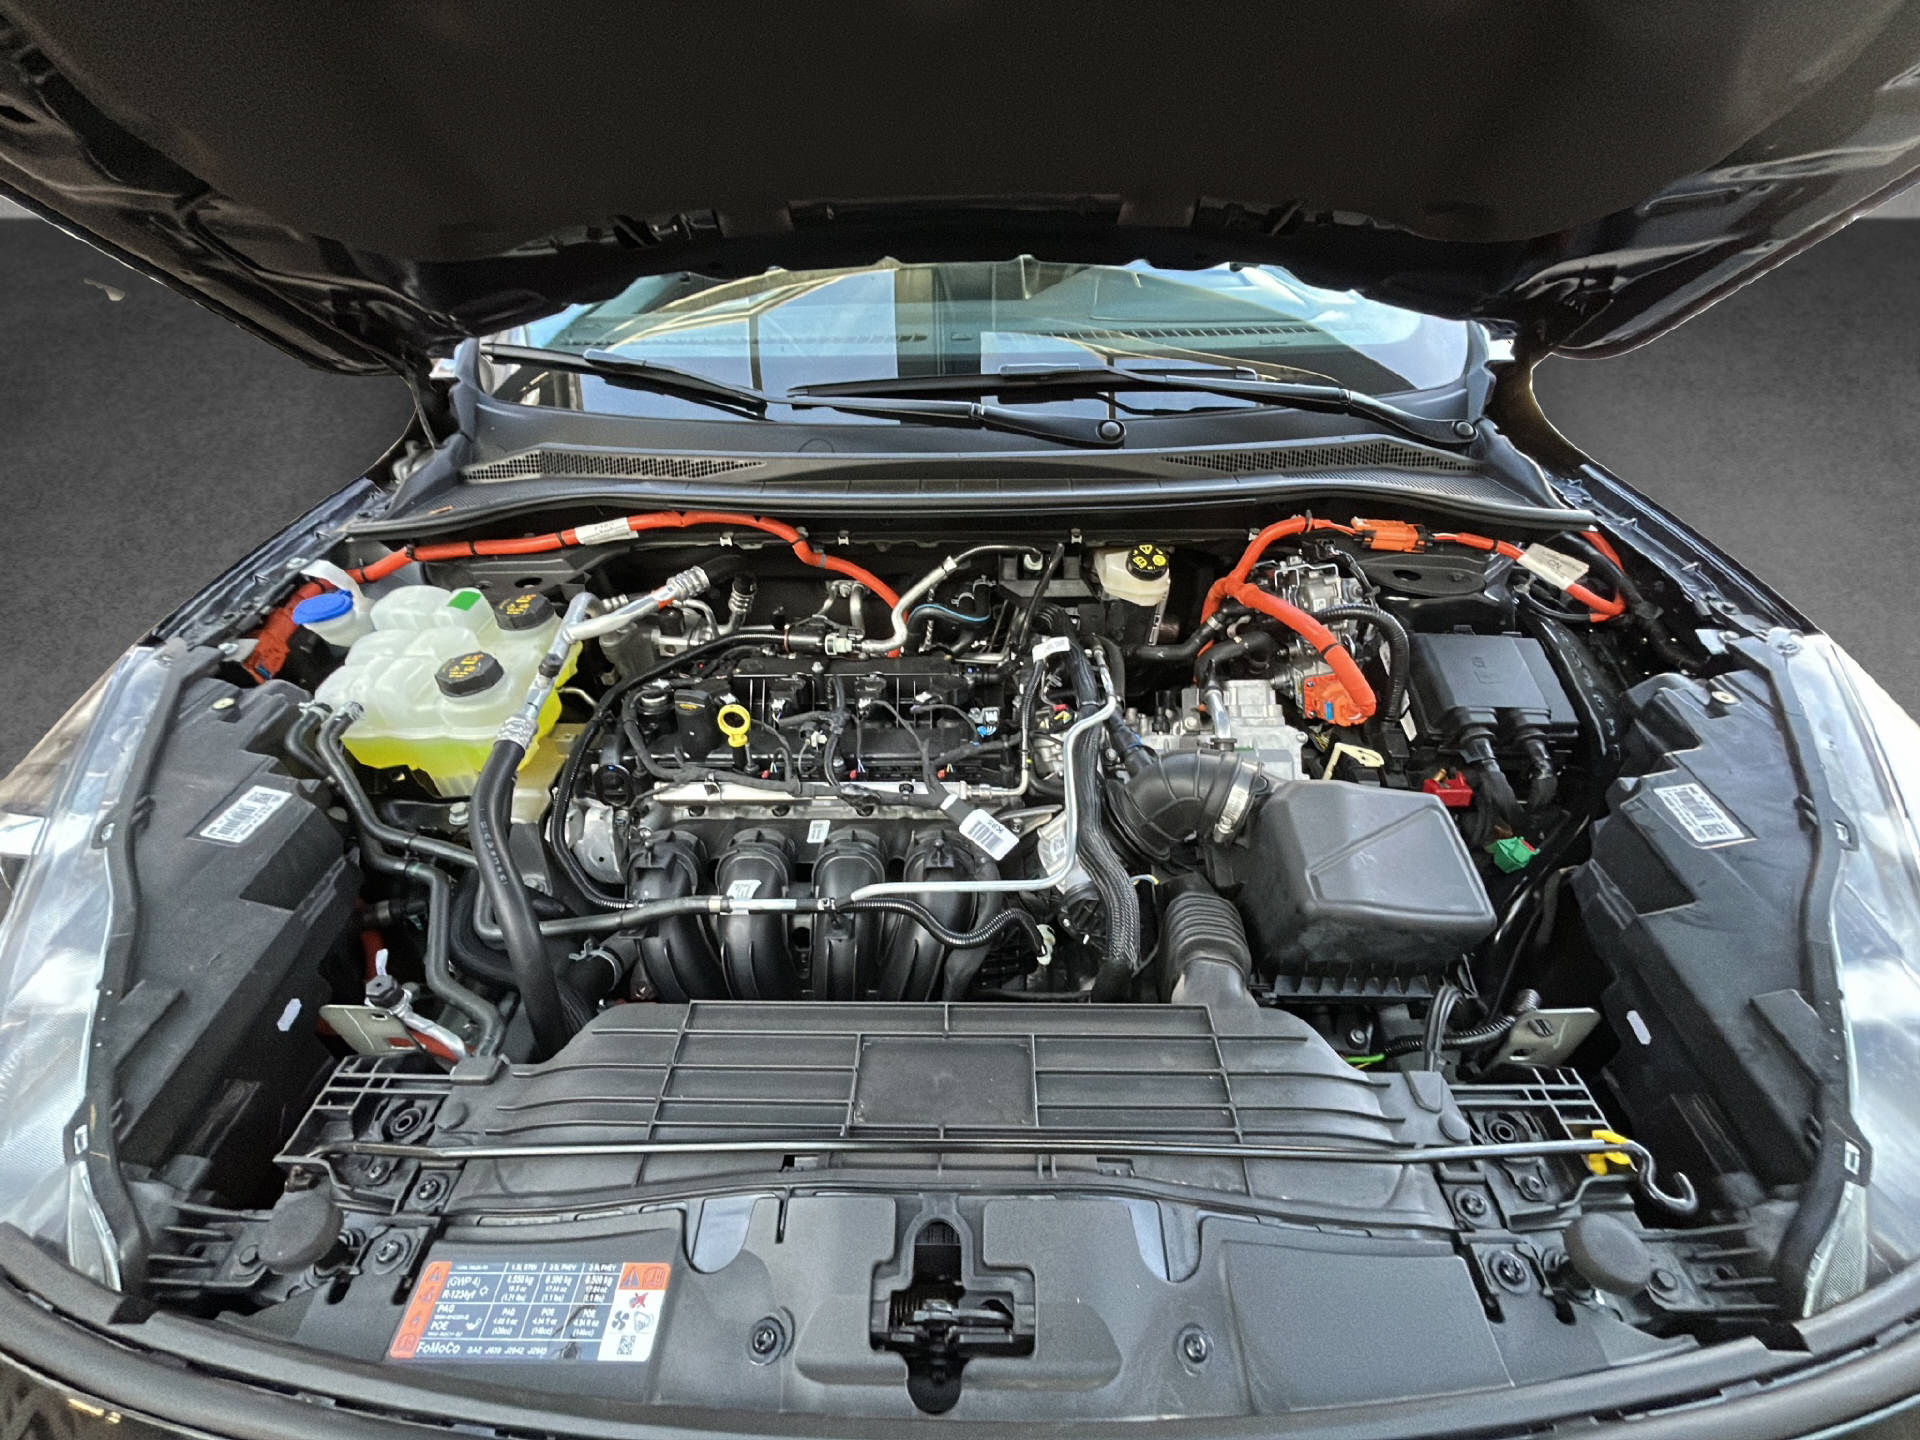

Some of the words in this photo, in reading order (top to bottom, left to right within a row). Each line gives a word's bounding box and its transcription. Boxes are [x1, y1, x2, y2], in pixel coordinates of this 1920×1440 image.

[447, 1276, 470, 1288] (GWP
[473, 1278, 481, 1288] 4)
[442, 1288, 476, 1300] R-1234yf
[438, 1304, 455, 1314] PAG
[503, 1308, 516, 1317] PAG
[542, 1308, 556, 1317] POE
[431, 1322, 450, 1330] POE
[417, 1342, 461, 1354] FoMoCo
